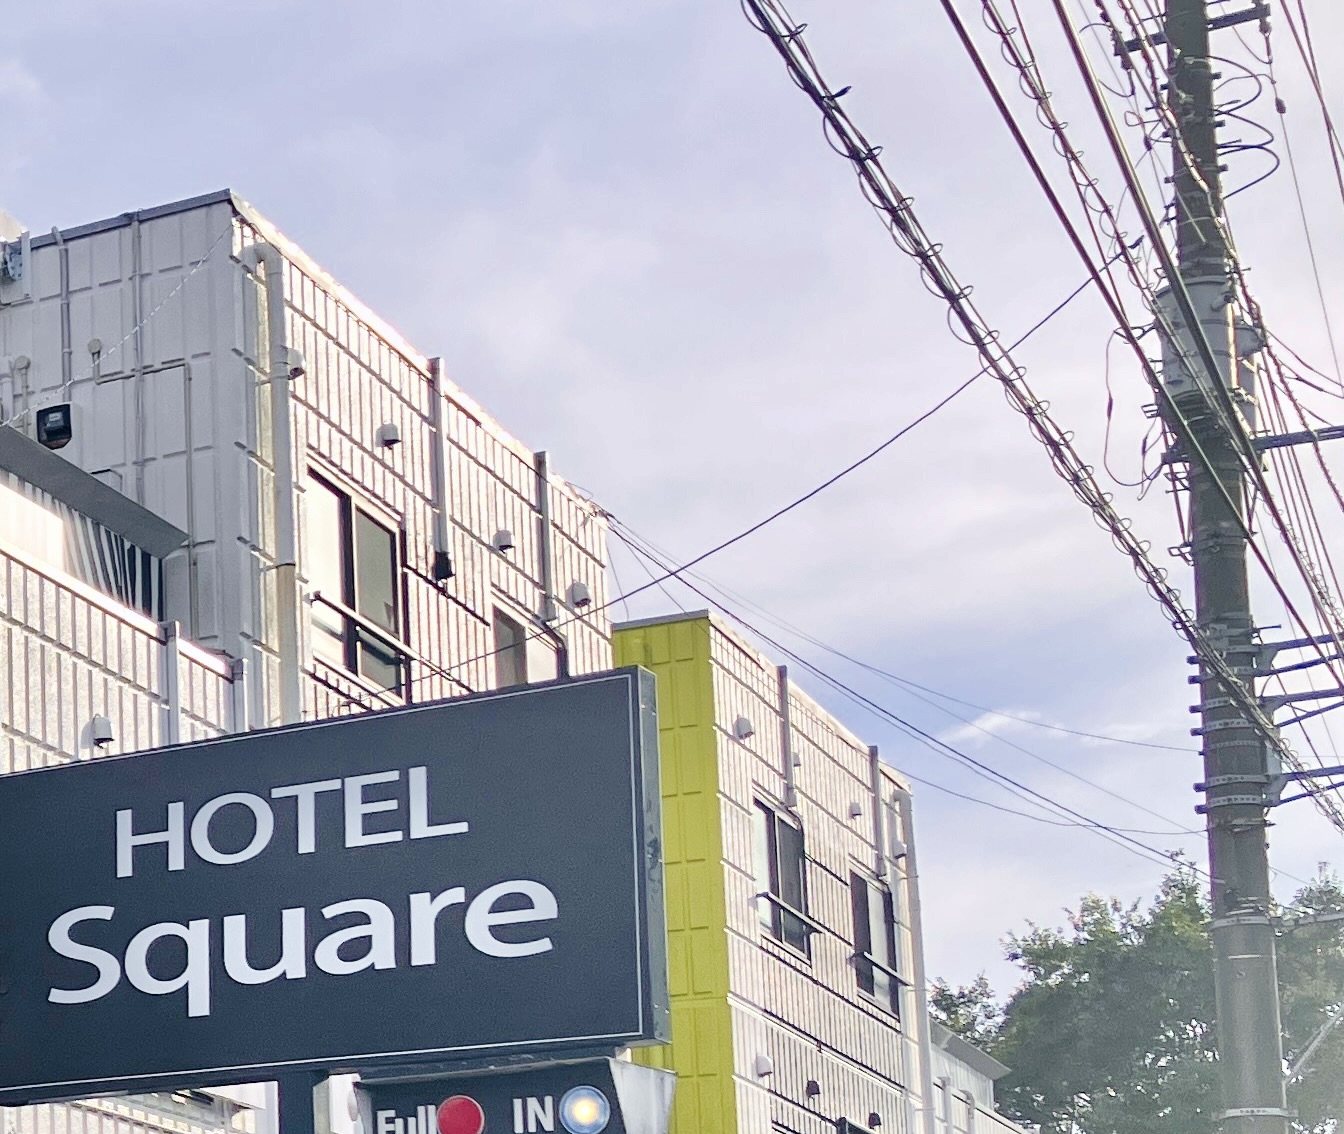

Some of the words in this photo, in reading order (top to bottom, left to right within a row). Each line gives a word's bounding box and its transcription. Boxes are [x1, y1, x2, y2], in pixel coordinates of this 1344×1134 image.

[115, 765, 469, 878] HOTEL
[47, 878, 559, 1017] Square
[513, 1096, 555, 1134] IN
